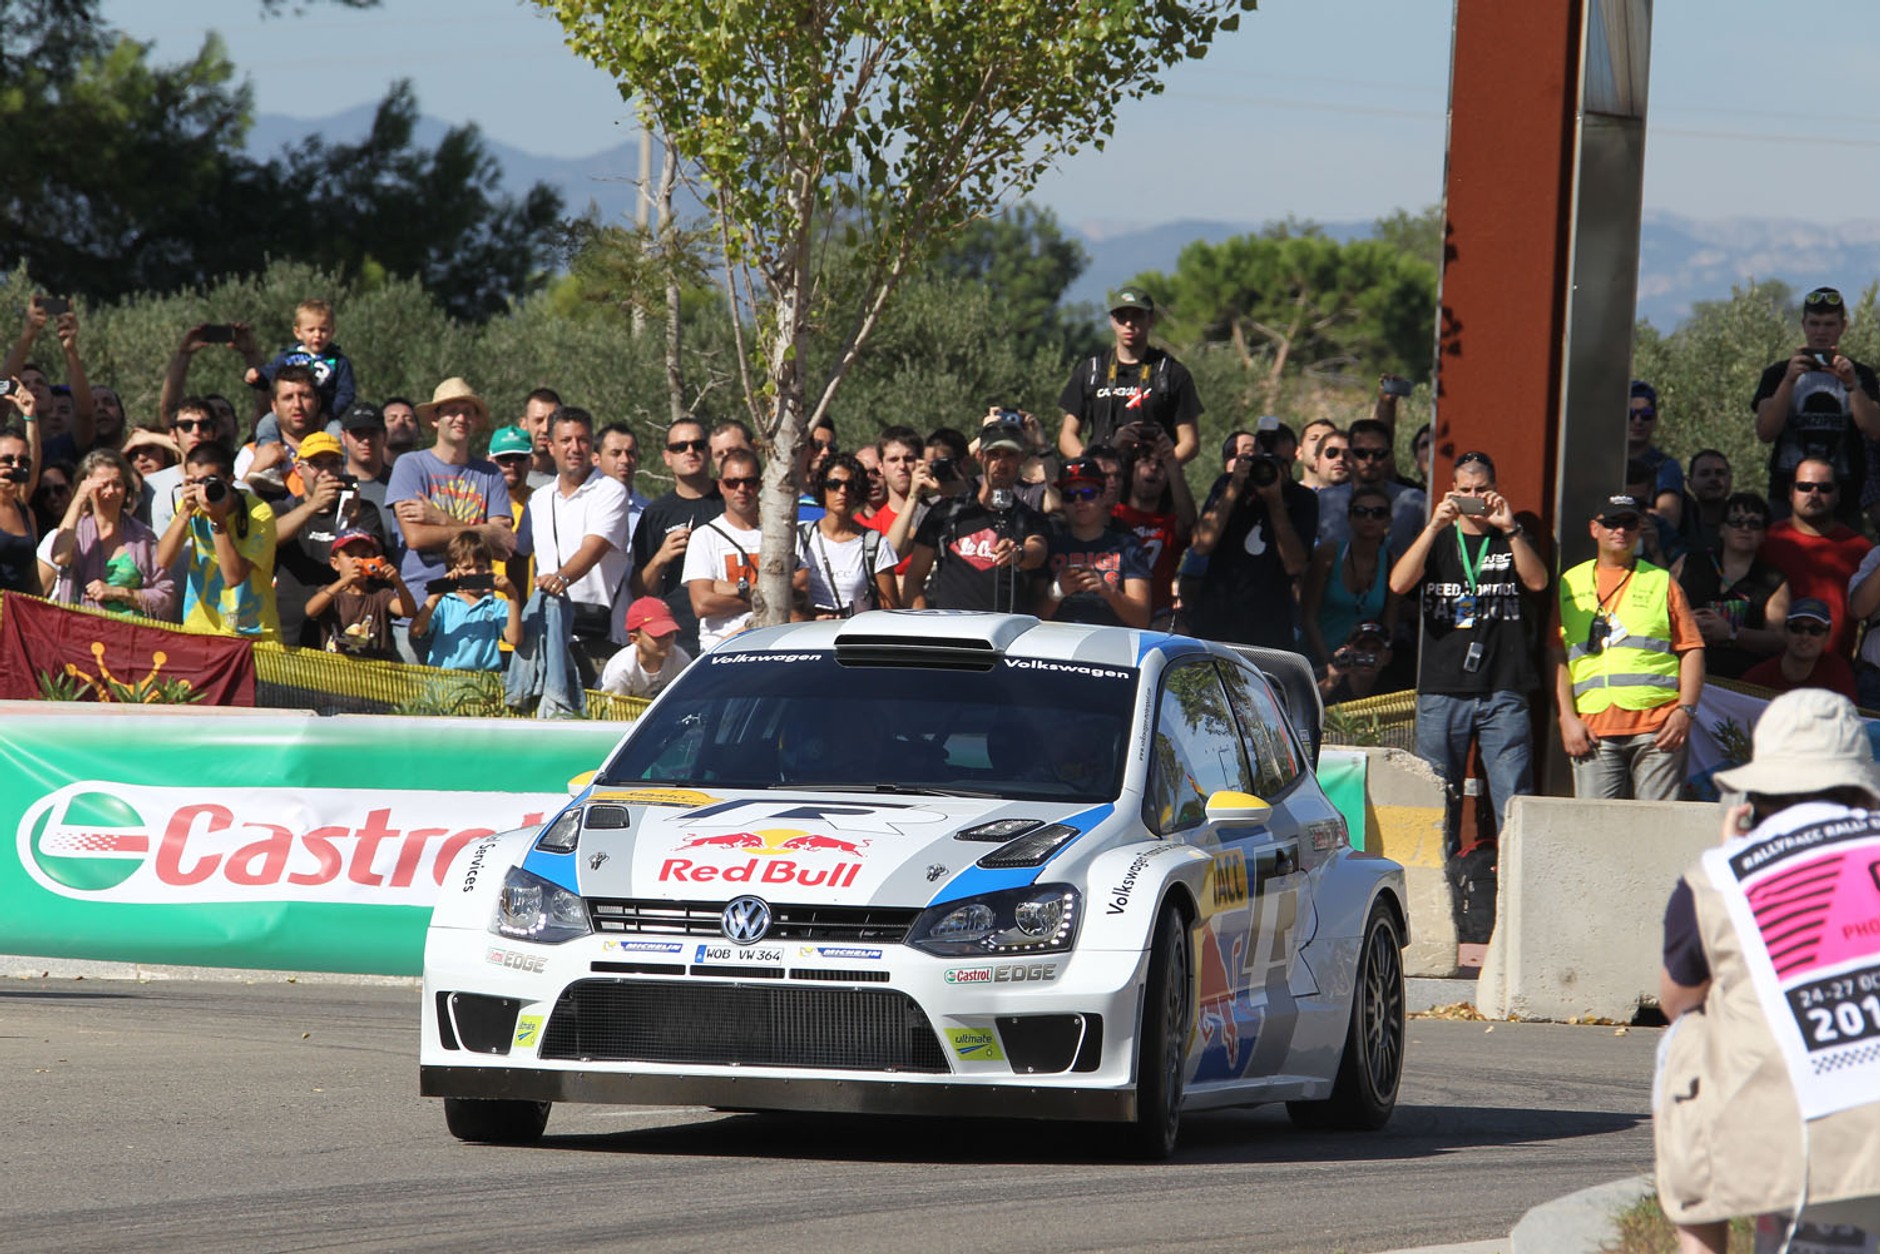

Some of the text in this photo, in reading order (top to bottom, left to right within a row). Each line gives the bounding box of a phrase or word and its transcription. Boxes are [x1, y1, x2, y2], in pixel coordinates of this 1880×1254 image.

[710, 652, 823, 666] Volkswagen
[1003, 658, 1130, 680] Volkswagen
[658, 858, 864, 888] Red Bull
[624, 943, 682, 952] MICHELIN
[706, 948, 781, 961] WOB VW 364
[823, 949, 882, 958] MICHELIN
[504, 951, 550, 974] EDGE
[957, 964, 1057, 983] Castrol EDGE
[1798, 979, 1854, 1008] 24-27
[955, 1034, 992, 1044] ultimate
